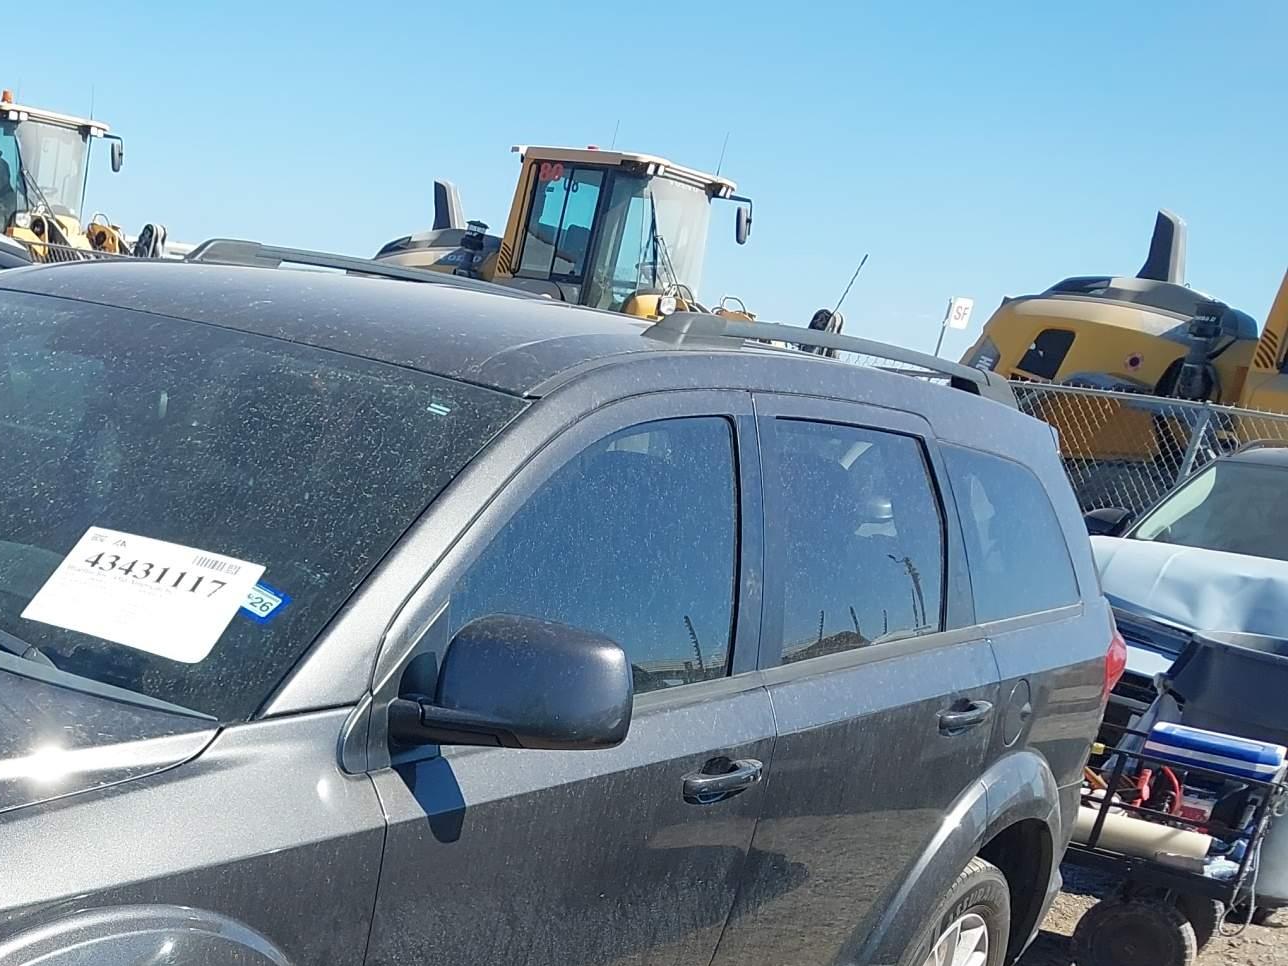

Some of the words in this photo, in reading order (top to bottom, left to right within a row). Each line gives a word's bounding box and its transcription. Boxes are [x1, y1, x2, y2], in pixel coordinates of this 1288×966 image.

[953, 303, 970, 322] SF
[84, 551, 228, 599] 43431117
[248, 596, 274, 613] 26
